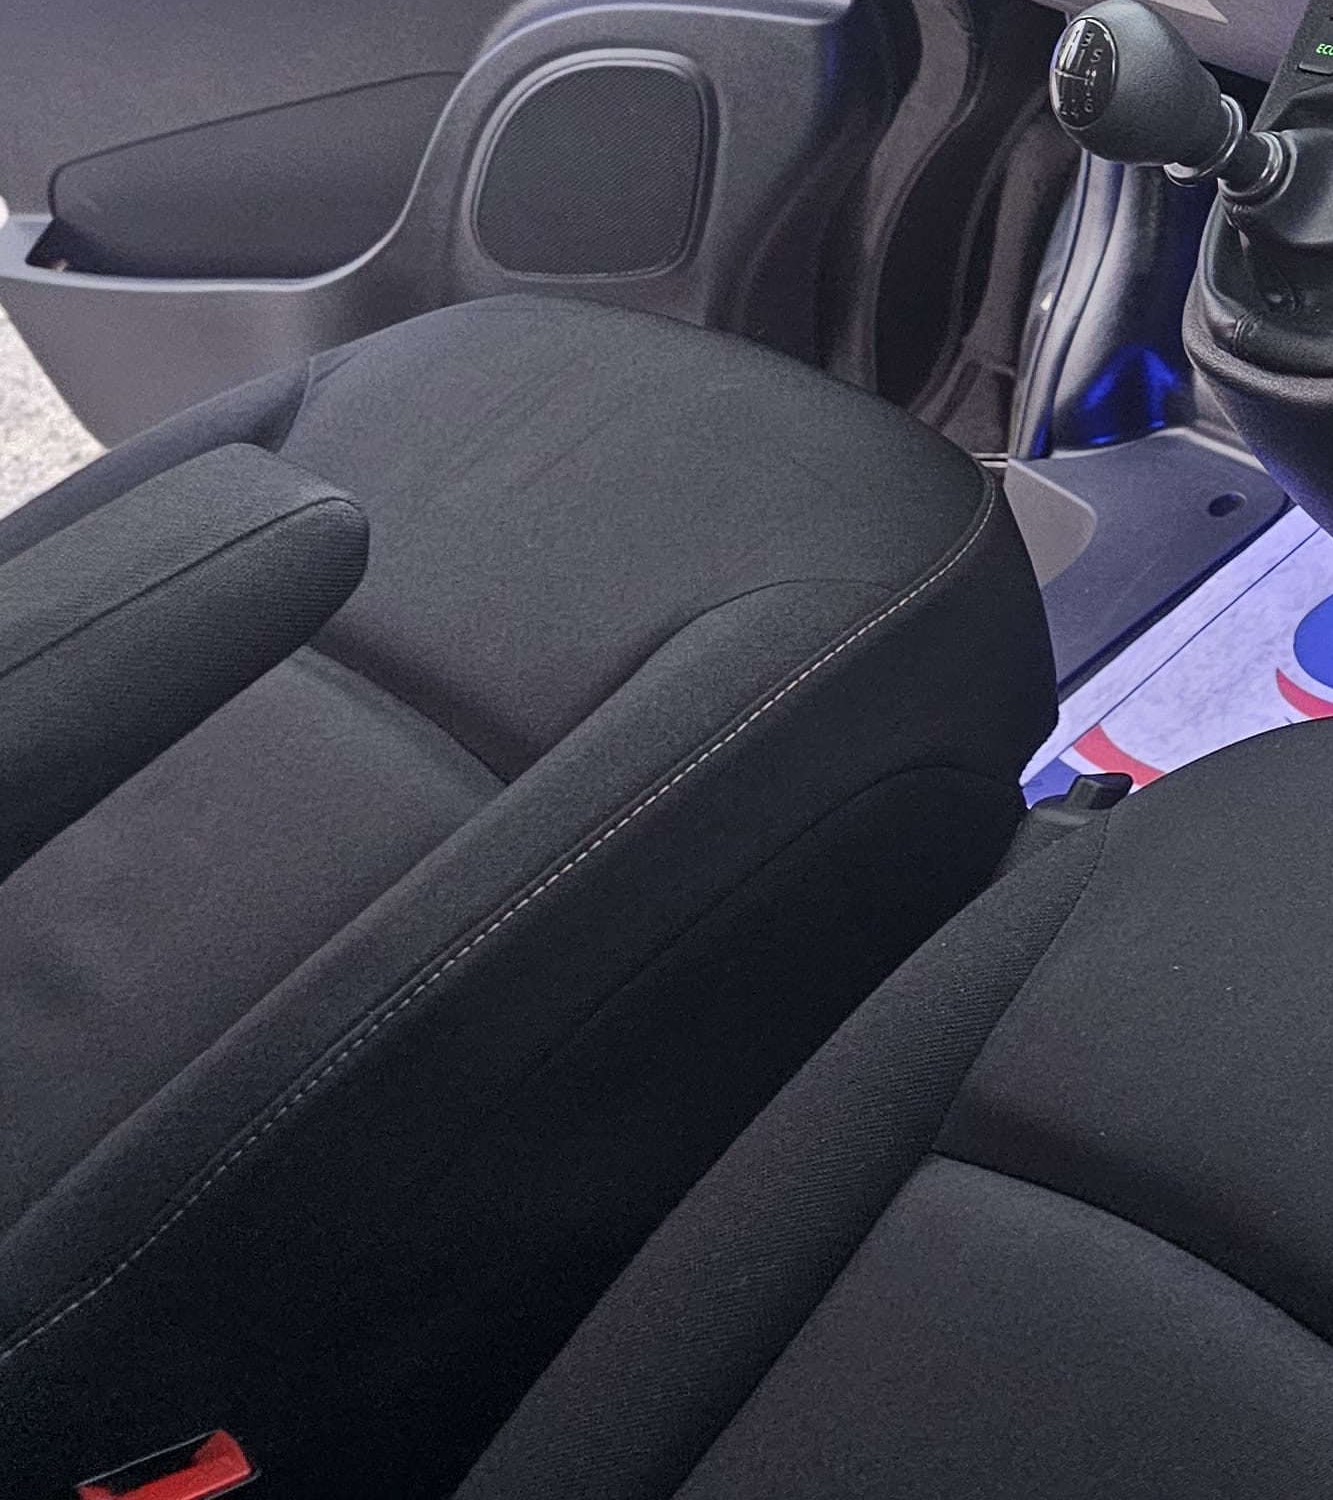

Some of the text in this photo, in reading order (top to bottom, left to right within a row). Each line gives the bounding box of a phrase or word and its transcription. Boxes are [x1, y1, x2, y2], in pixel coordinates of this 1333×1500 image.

[1080, 31, 1095, 47] 3
[1089, 48, 1104, 63] 5
[1084, 98, 1095, 113] 6
